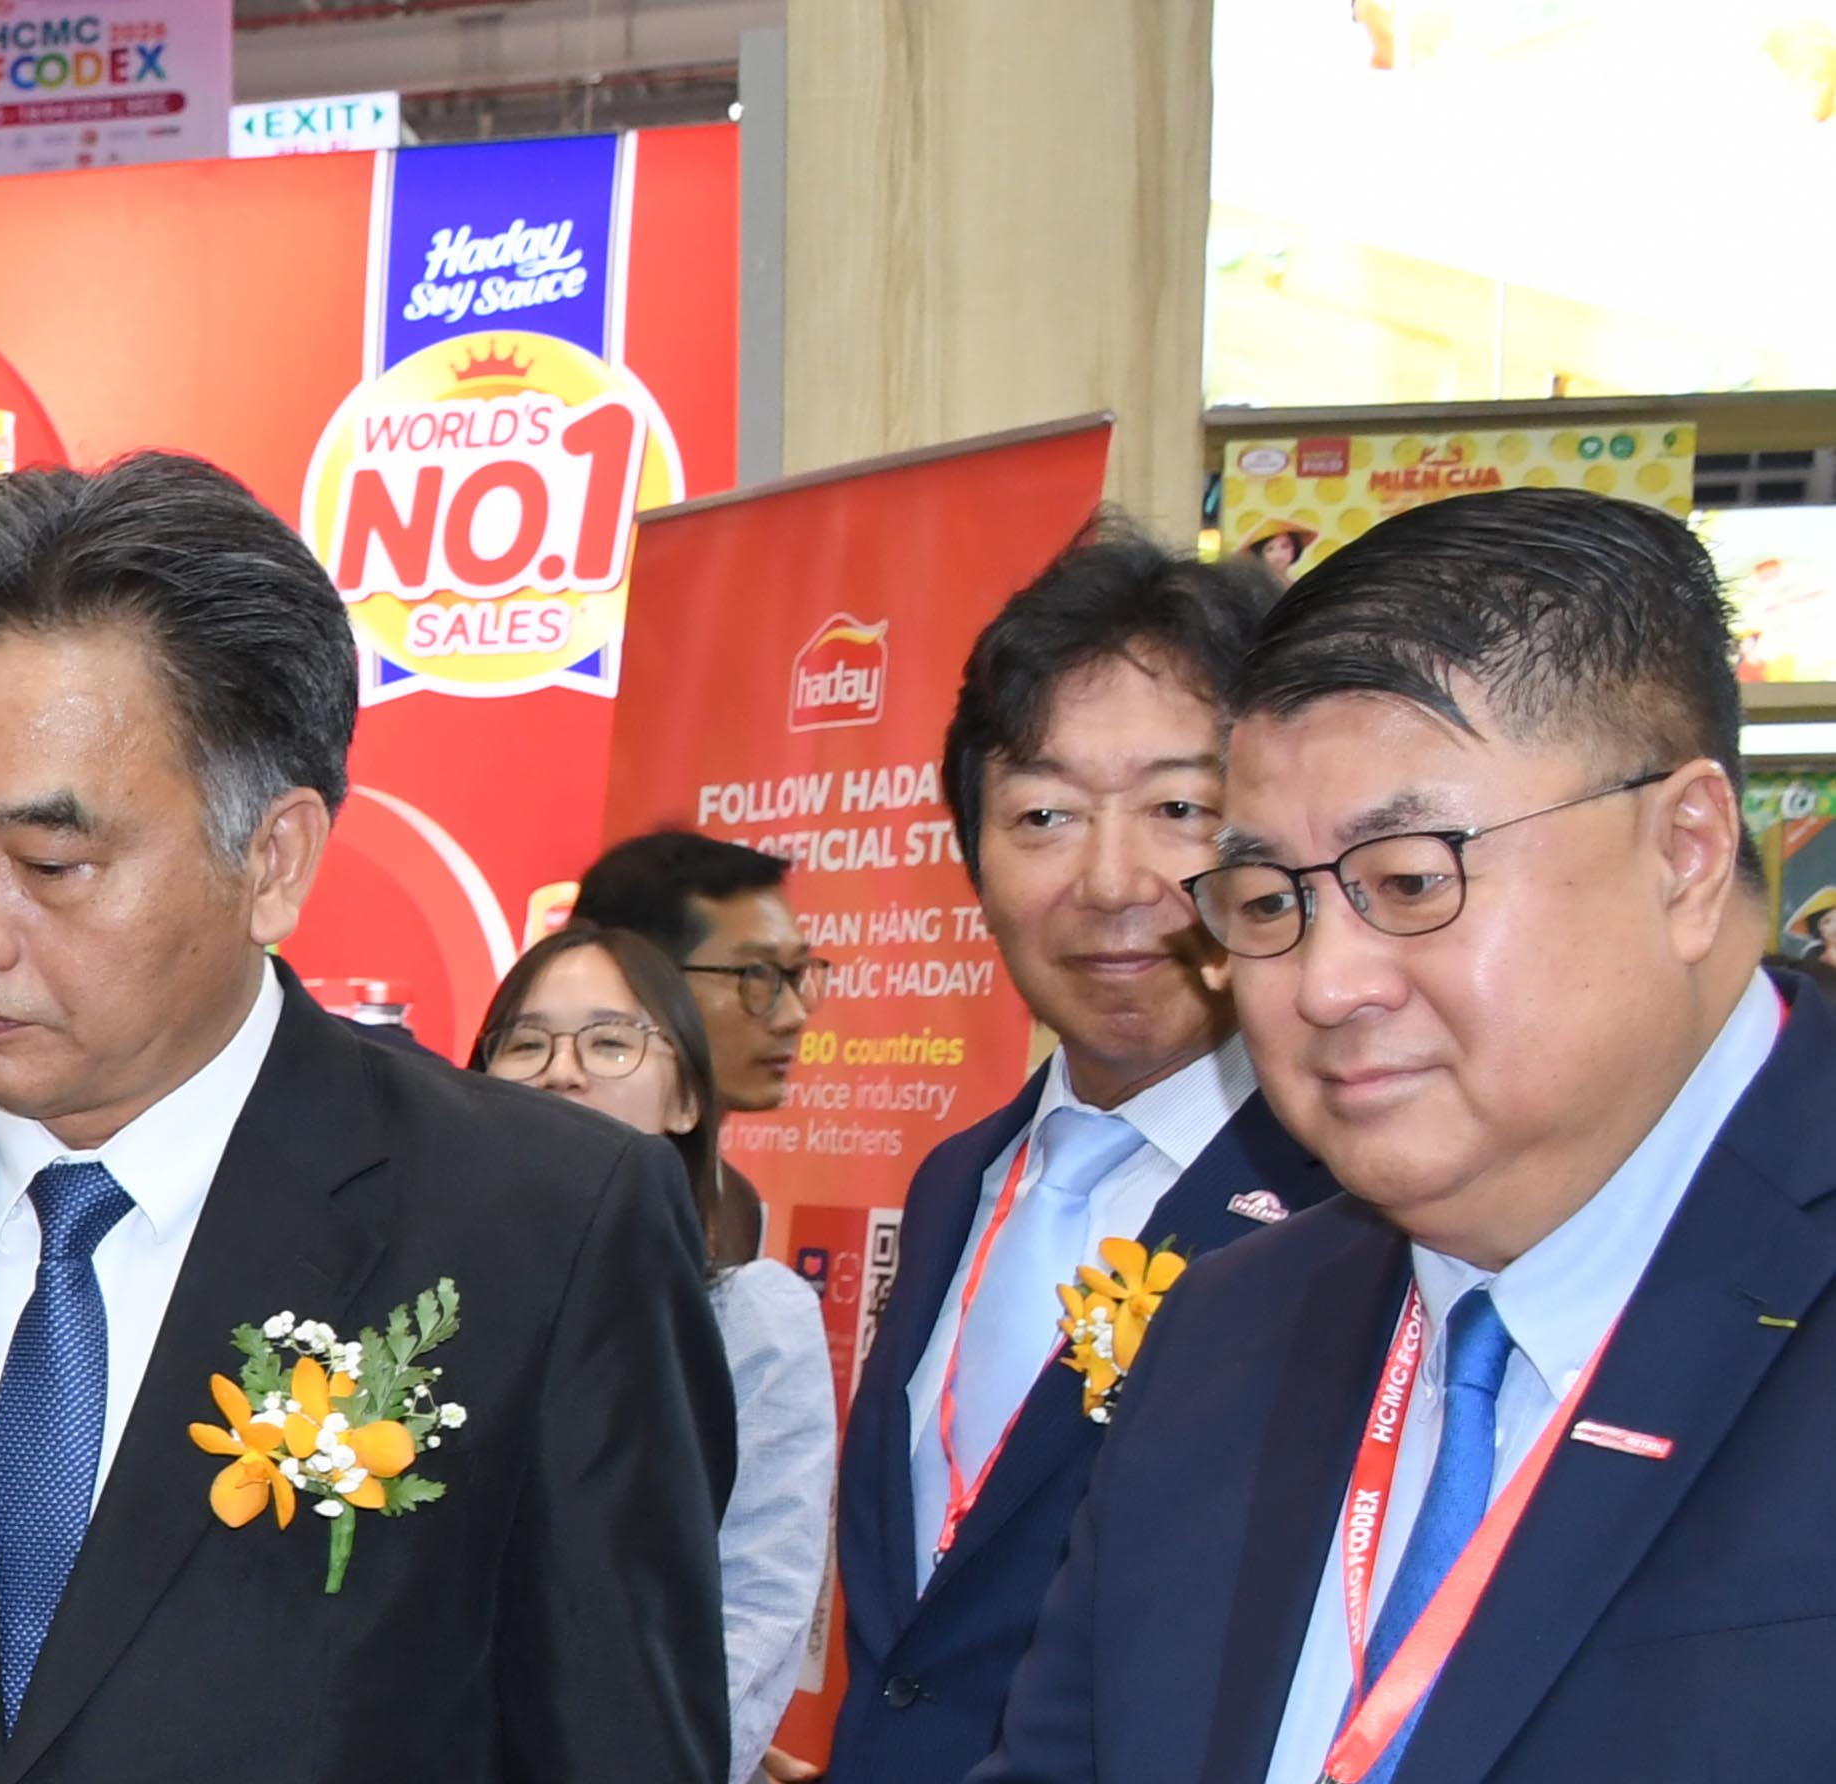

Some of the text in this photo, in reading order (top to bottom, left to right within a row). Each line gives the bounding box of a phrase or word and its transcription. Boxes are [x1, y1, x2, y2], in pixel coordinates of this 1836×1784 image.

[265, 103, 359, 139] EXIT
[425, 218, 582, 281] Haday
[403, 267, 587, 323] Soy Sauce
[363, 405, 553, 454] WORLD'S
[414, 609, 563, 648] SALES
[796, 658, 882, 717] haday
[698, 763, 941, 826] FOLLOW HADA
[885, 961, 996, 998] HADAY!
[799, 1027, 965, 1066] 80 countries
[857, 1072, 957, 1120] industry
[806, 1117, 903, 1155] kitchens
[1372, 1363, 1409, 1444] HCMC
